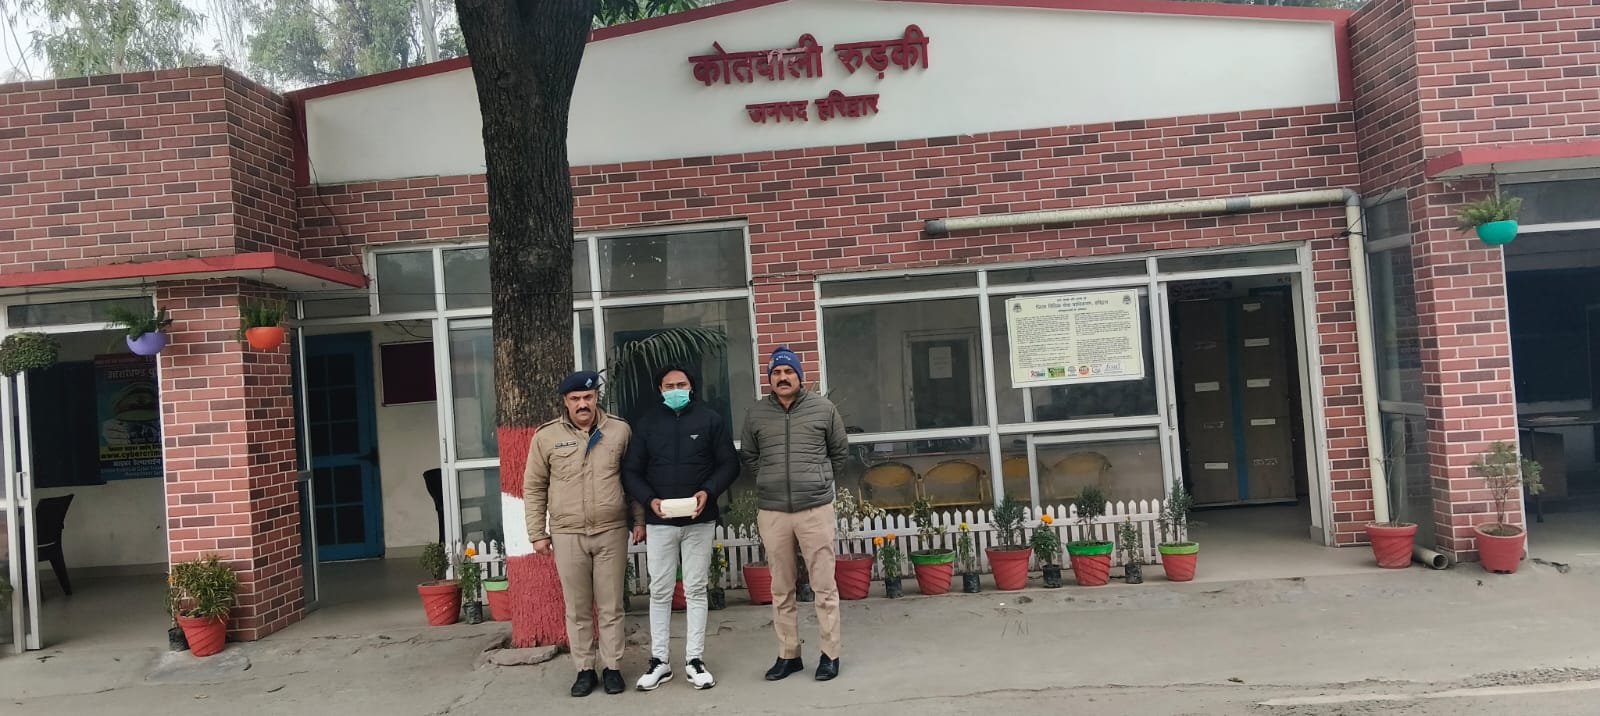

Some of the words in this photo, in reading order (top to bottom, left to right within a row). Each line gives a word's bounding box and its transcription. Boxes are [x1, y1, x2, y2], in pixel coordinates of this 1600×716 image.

[688, 33, 823, 86] कोतवाली
[834, 24, 930, 80] रुड़की
[745, 100, 809, 124] जनपद
[815, 89, 880, 121] हरिद्वार
